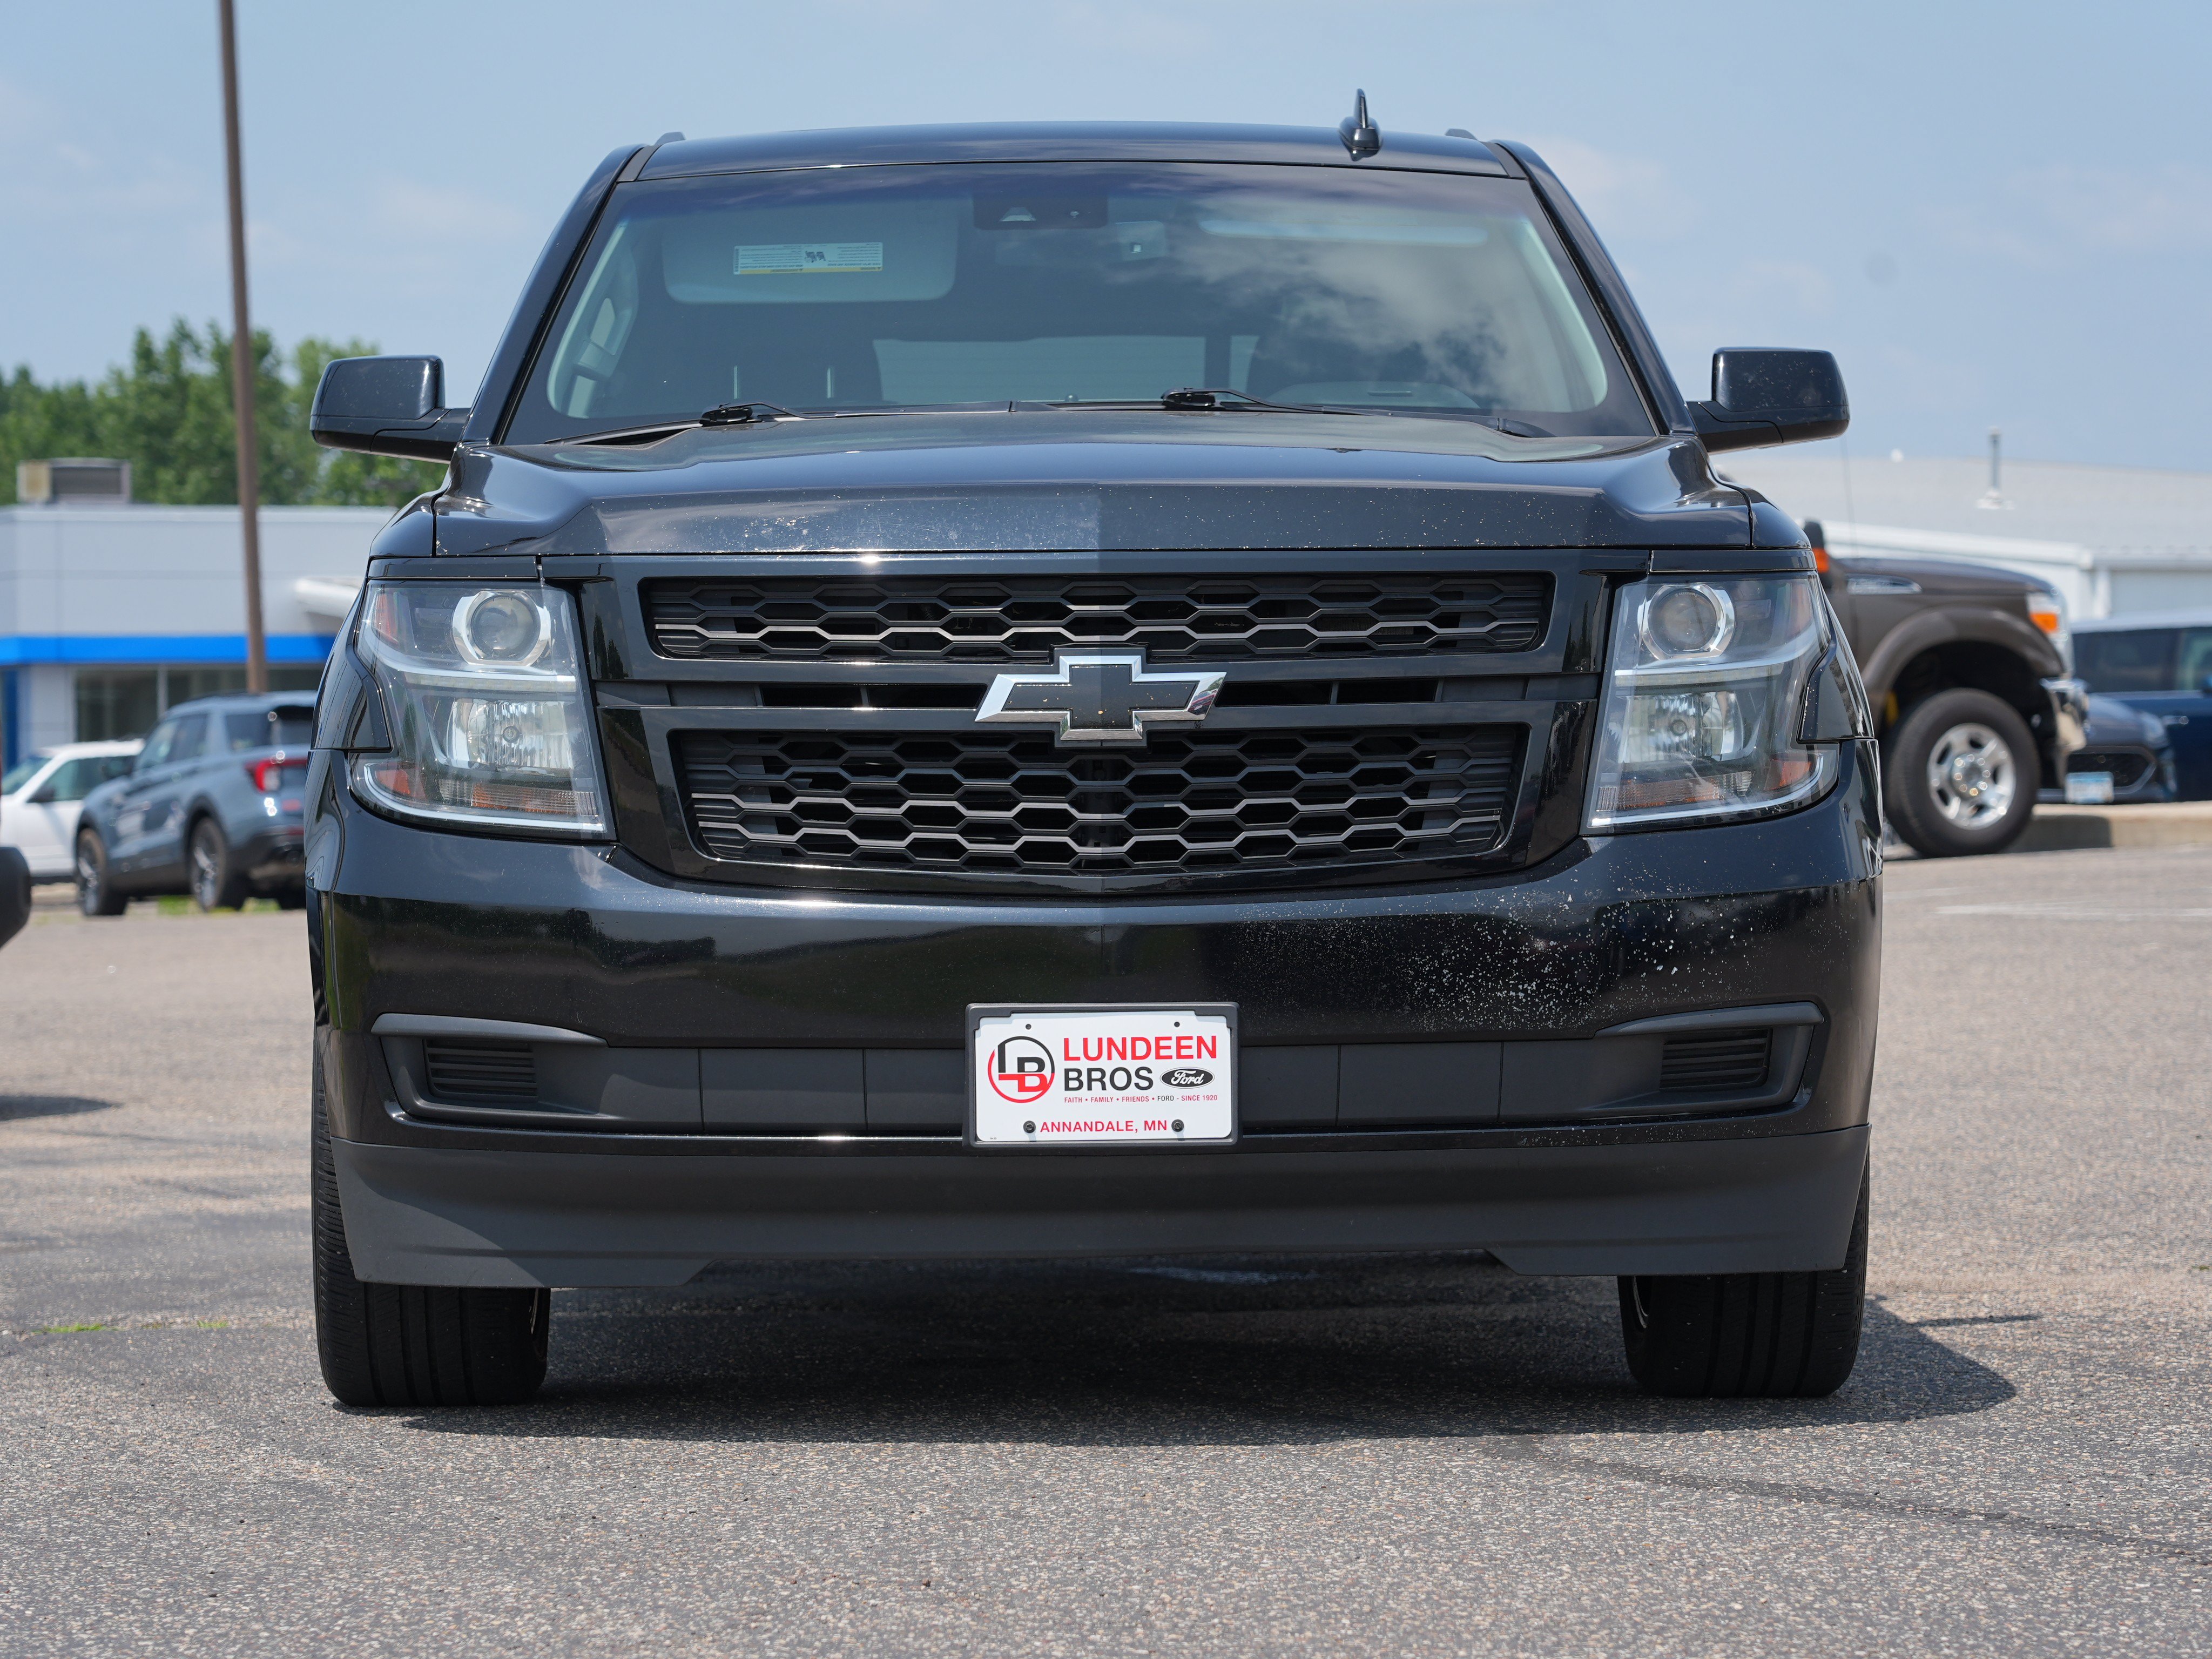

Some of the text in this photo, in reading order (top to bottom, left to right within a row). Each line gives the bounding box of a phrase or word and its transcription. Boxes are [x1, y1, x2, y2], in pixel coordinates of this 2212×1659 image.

[1063, 1035, 1217, 1061] LUNDEEN
[1064, 1066, 1154, 1091] BROS
[1171, 1070, 1205, 1084] Ford
[1040, 1120, 1167, 1134] ANNANDALE, MN
